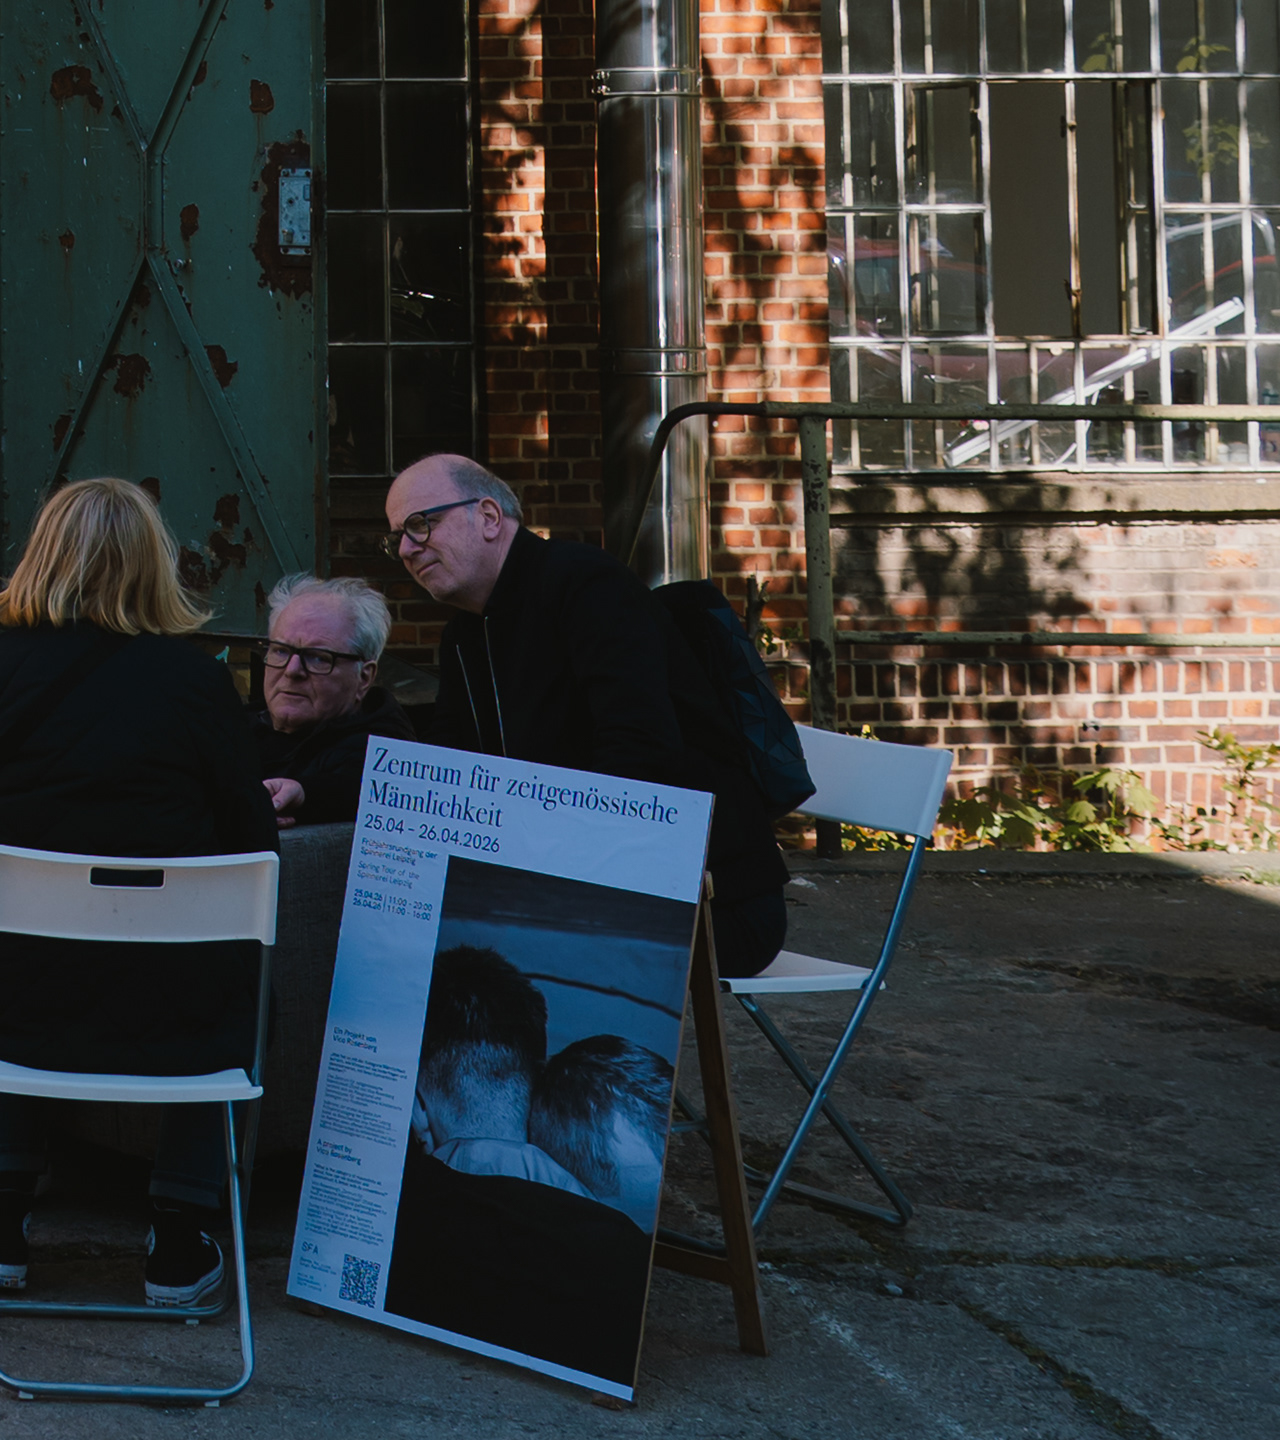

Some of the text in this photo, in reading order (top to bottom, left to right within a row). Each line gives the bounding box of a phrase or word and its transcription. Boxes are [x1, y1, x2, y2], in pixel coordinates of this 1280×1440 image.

[371, 746, 679, 825] Zentrum für zeitgenössische
[367, 779, 504, 828] Männlichkeit
[364, 812, 404, 836] 25.04
[418, 823, 501, 854] 26.04.2026
[360, 846, 416, 866] Spinnerei Leipzig
[425, 850, 438, 860] der
[356, 869, 413, 890] Spinnerei Leipzig
[357, 860, 420, 880] Spring Tour of the
